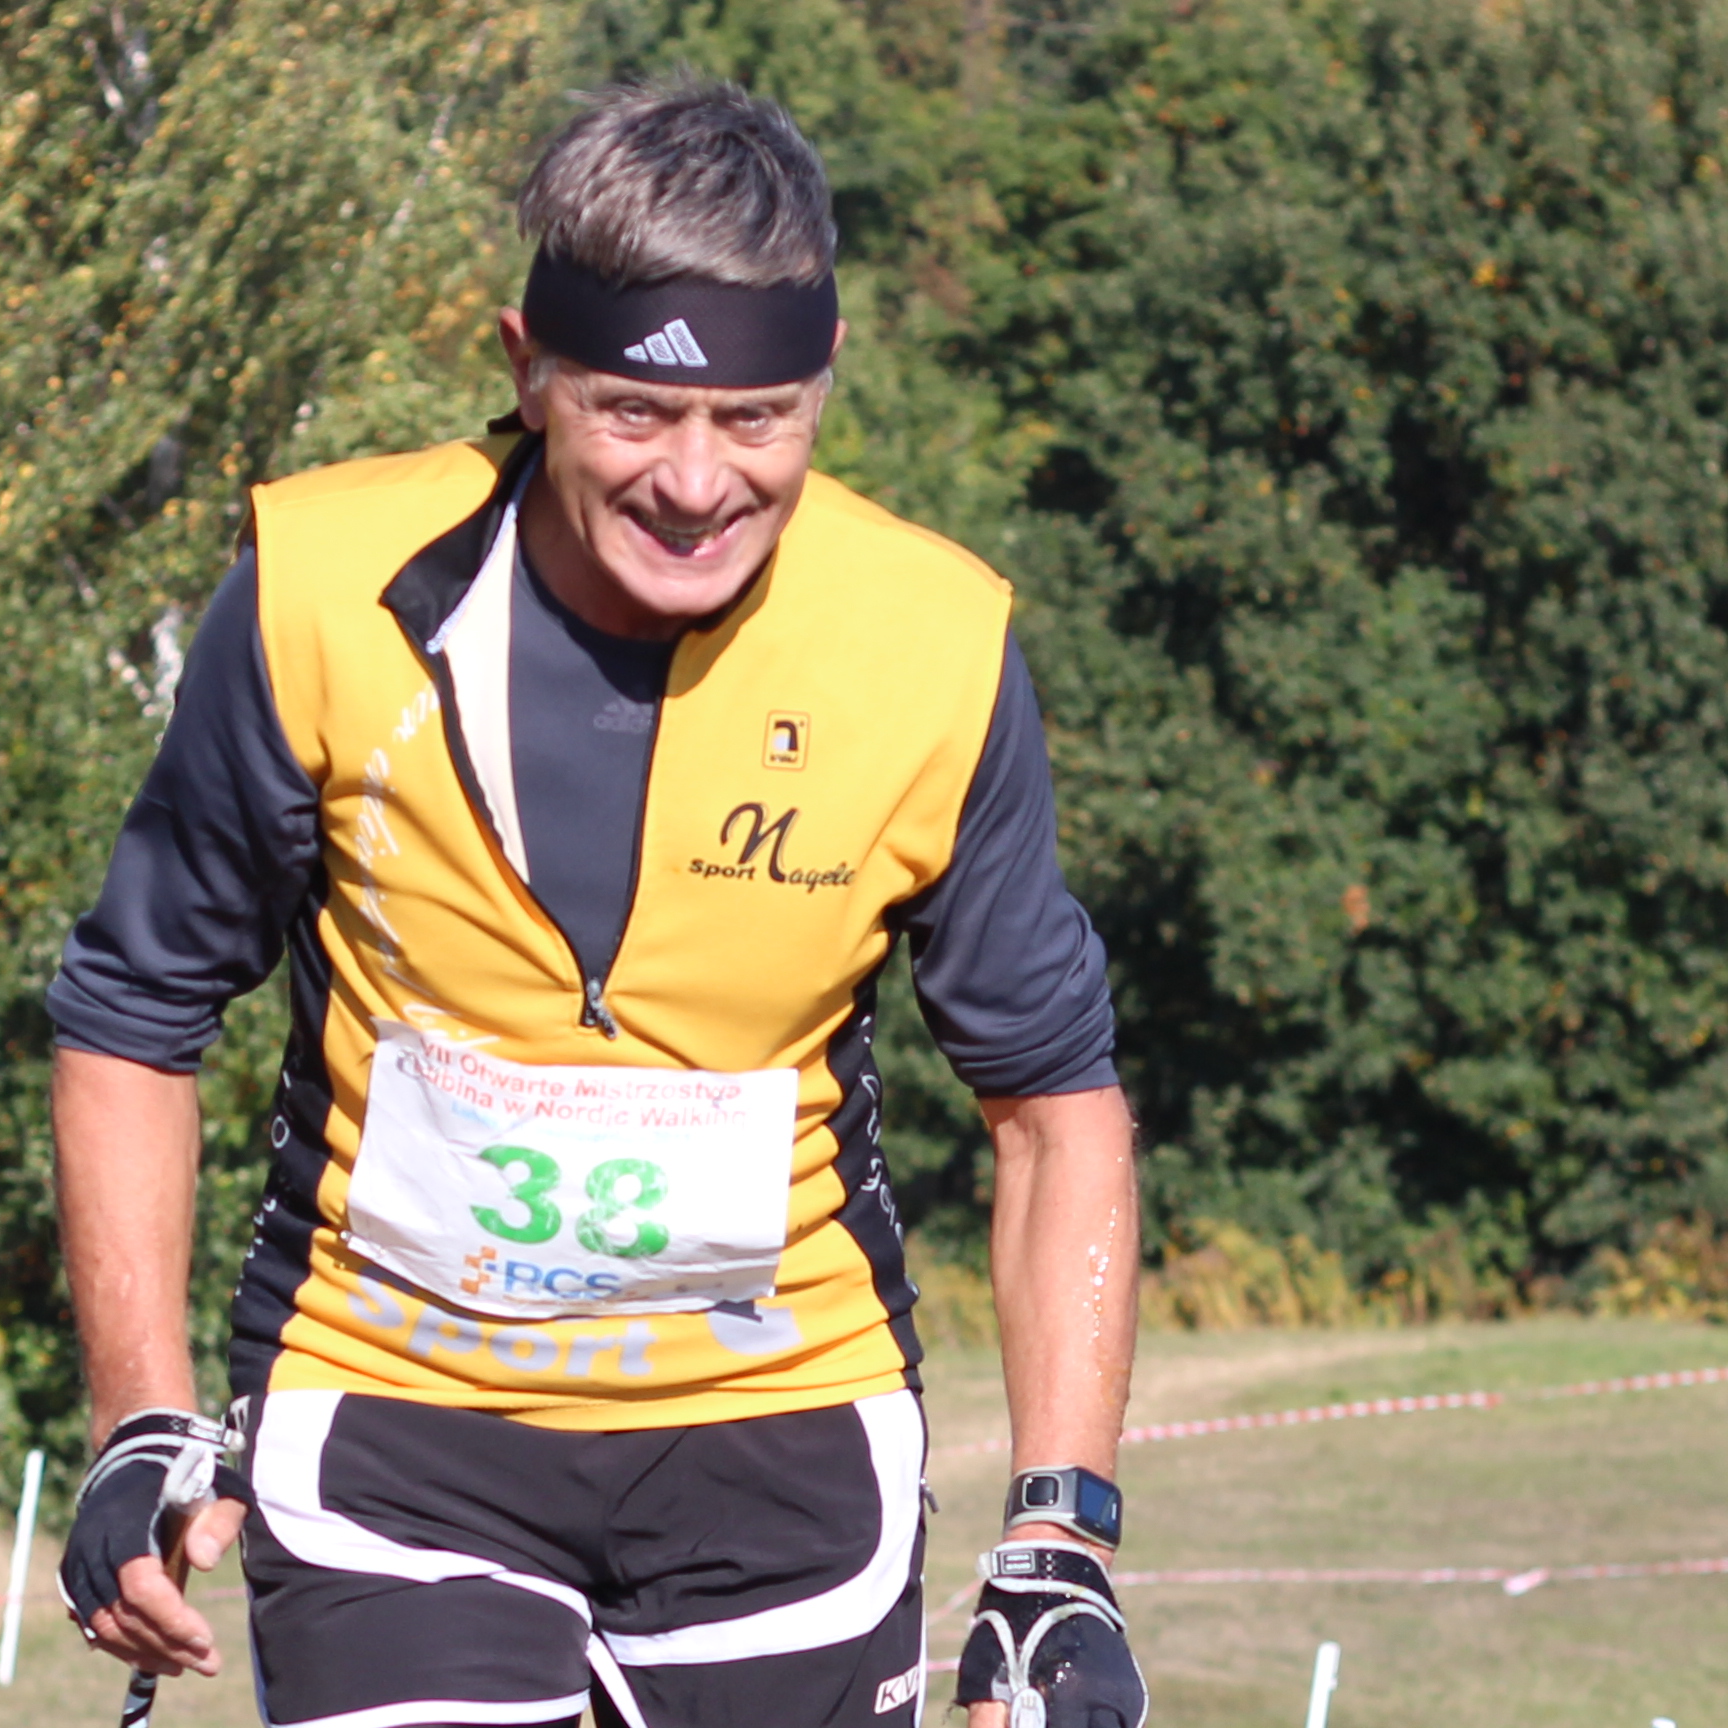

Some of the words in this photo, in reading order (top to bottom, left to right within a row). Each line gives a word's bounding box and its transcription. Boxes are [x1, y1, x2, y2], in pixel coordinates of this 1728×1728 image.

[688, 858, 756, 881] Sport
[459, 1053, 565, 1098] Otwarte
[503, 1097, 526, 1116] w
[534, 1100, 630, 1127] Nordic
[470, 1144, 670, 1259] 38
[503, 1260, 622, 1300] RCS
[879, 1668, 920, 1710] KV
